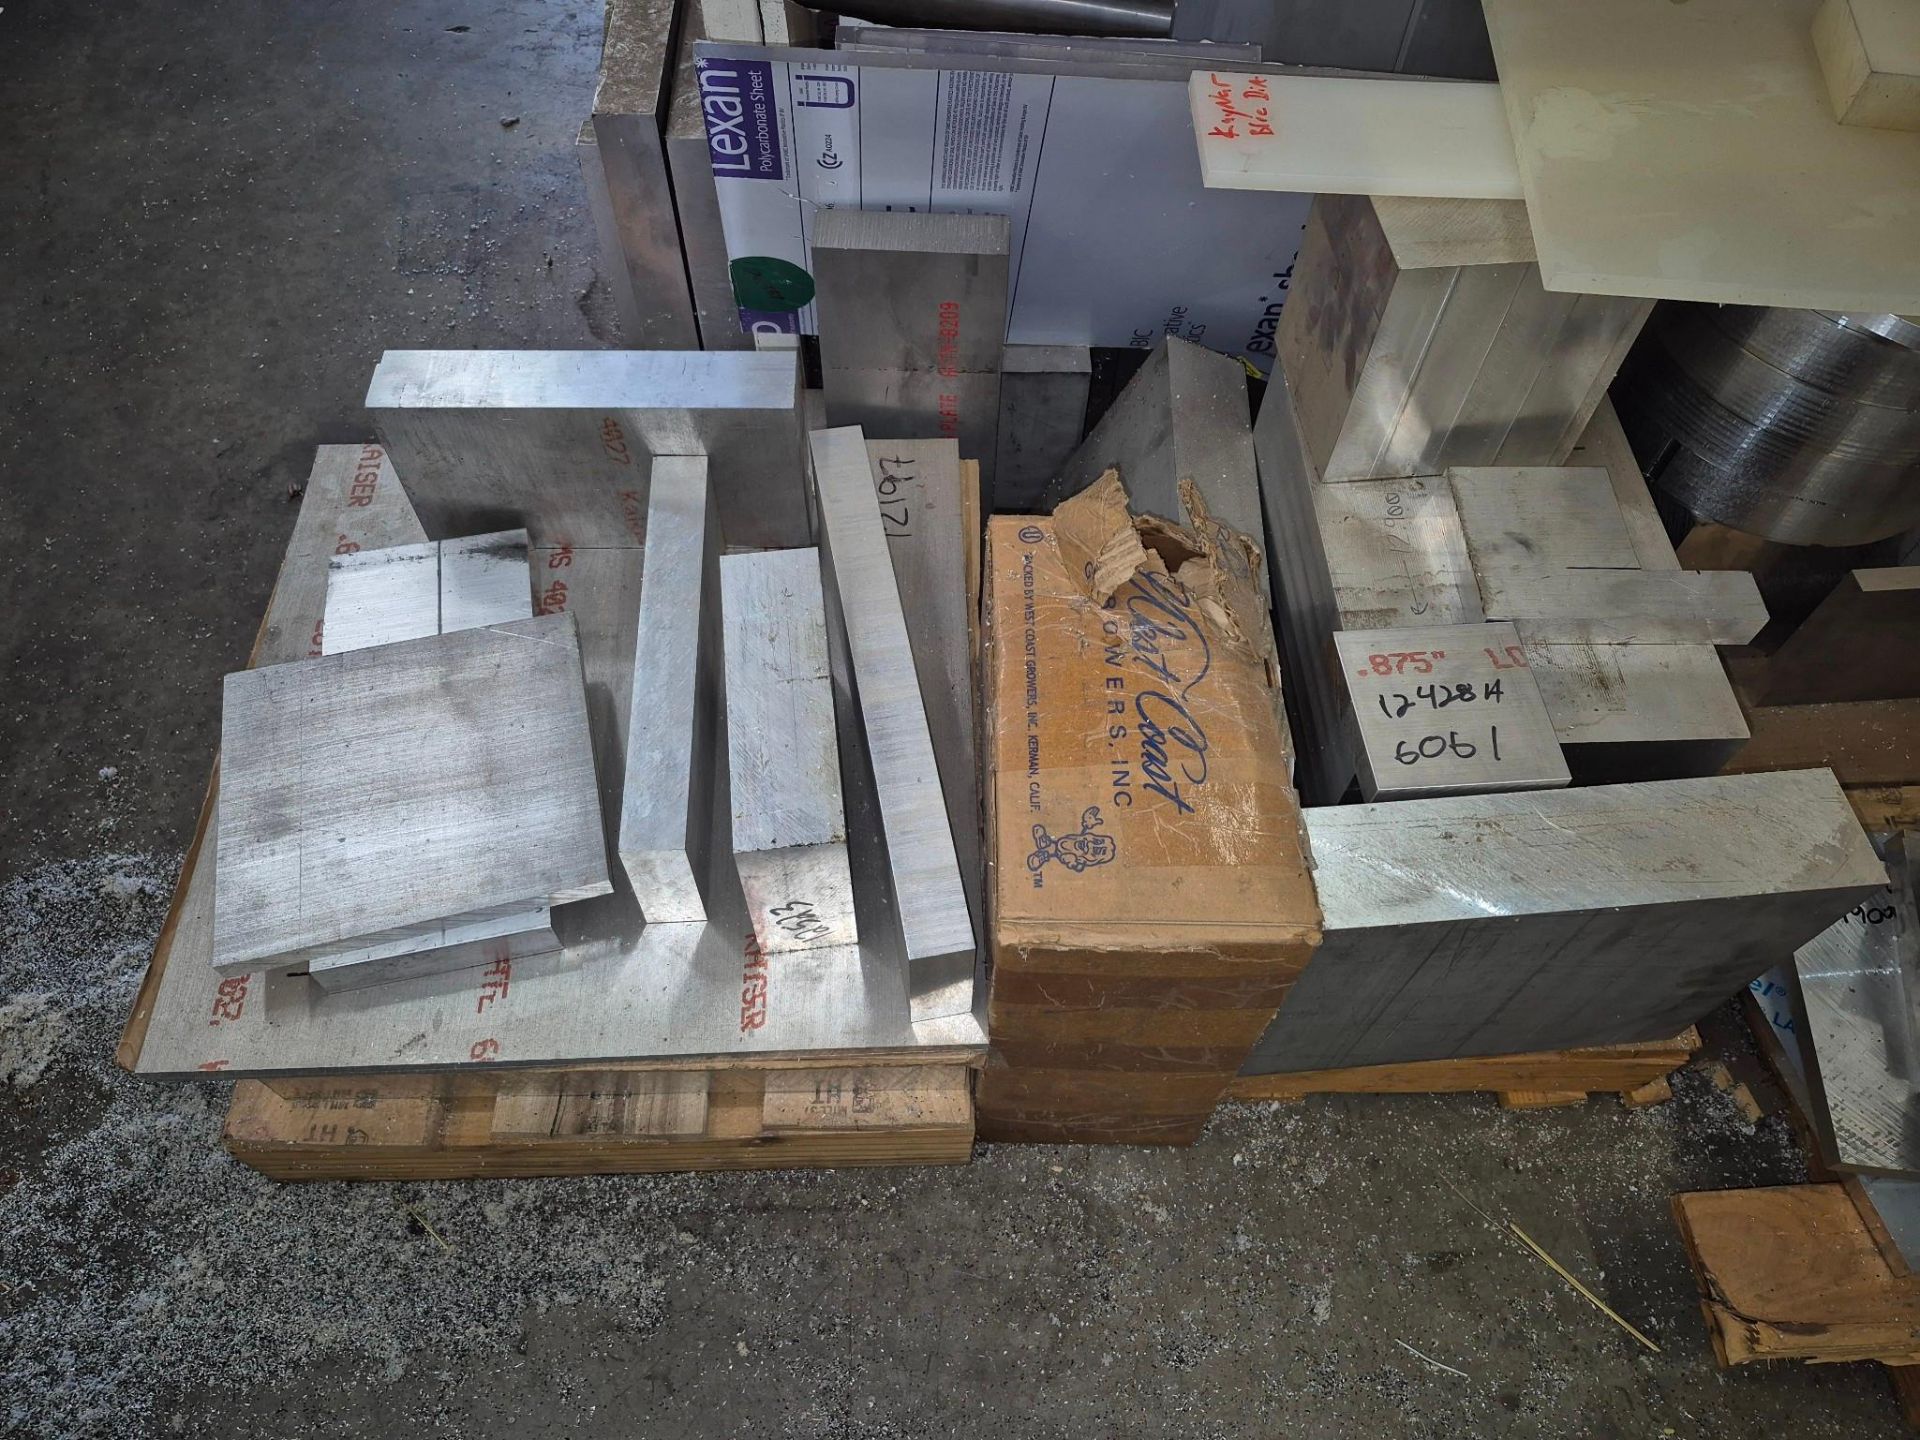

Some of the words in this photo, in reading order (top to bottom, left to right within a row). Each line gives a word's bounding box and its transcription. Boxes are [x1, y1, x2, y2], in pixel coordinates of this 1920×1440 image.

[748, 69, 765, 101] Sheet
[751, 103, 774, 172] Polycarbonate
[878, 454, 915, 538] 12197
[1023, 589, 1035, 600] BY
[1024, 603, 1036, 626] WEST
[1025, 628, 1036, 657] COAST
[1127, 571, 1210, 701] West
[1026, 659, 1038, 709] GROWERS,
[1028, 735, 1040, 778] KERMAN,
[1135, 690, 1209, 816] Coast
[1029, 782, 1041, 813] CALIF.
[1033, 871, 1043, 888] TM
